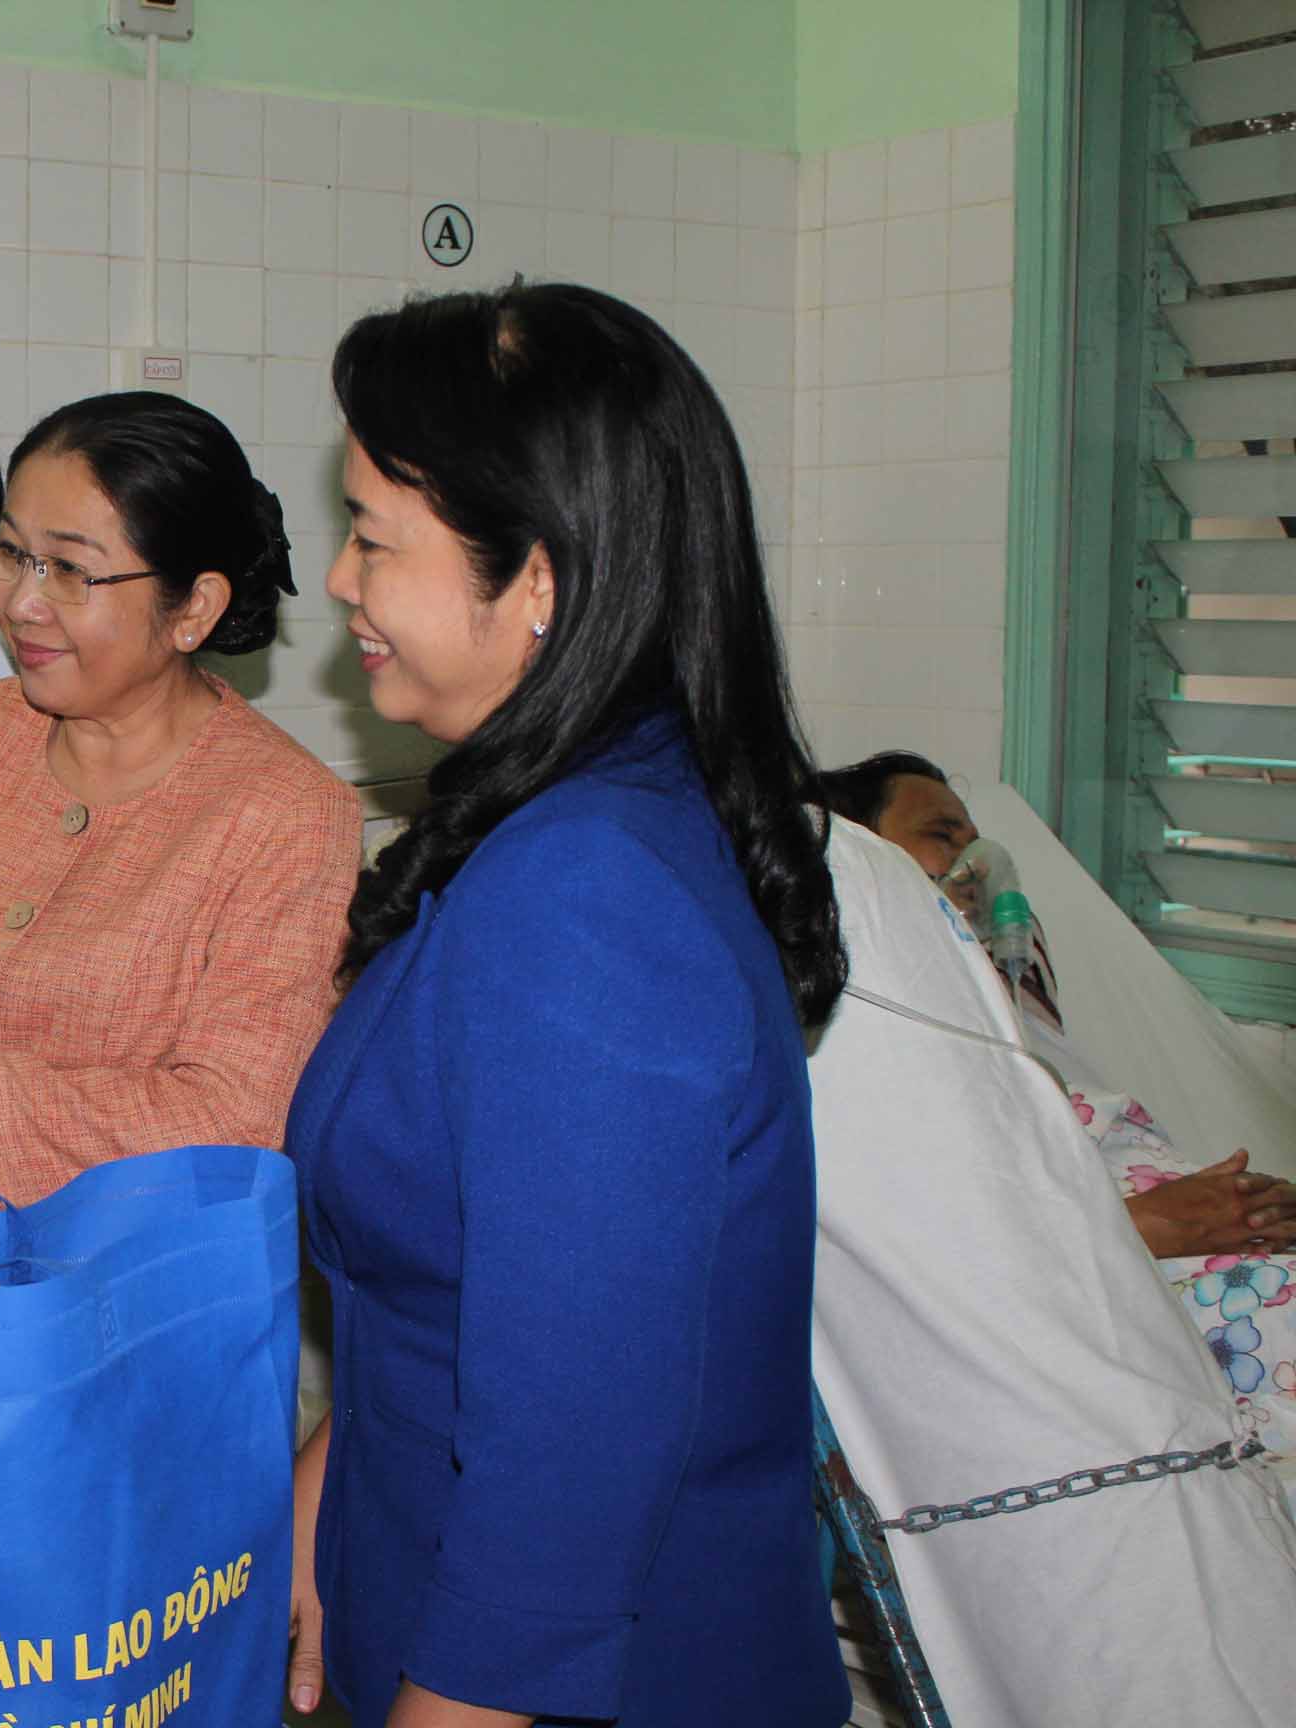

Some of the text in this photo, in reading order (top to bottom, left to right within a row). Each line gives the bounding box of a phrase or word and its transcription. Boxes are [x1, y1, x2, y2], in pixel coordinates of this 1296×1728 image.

[433, 215, 462, 250] A
[74, 1608, 152, 1682] LAO
[162, 1552, 253, 1640] ĐỘNG
[125, 1661, 192, 1728] MINH
